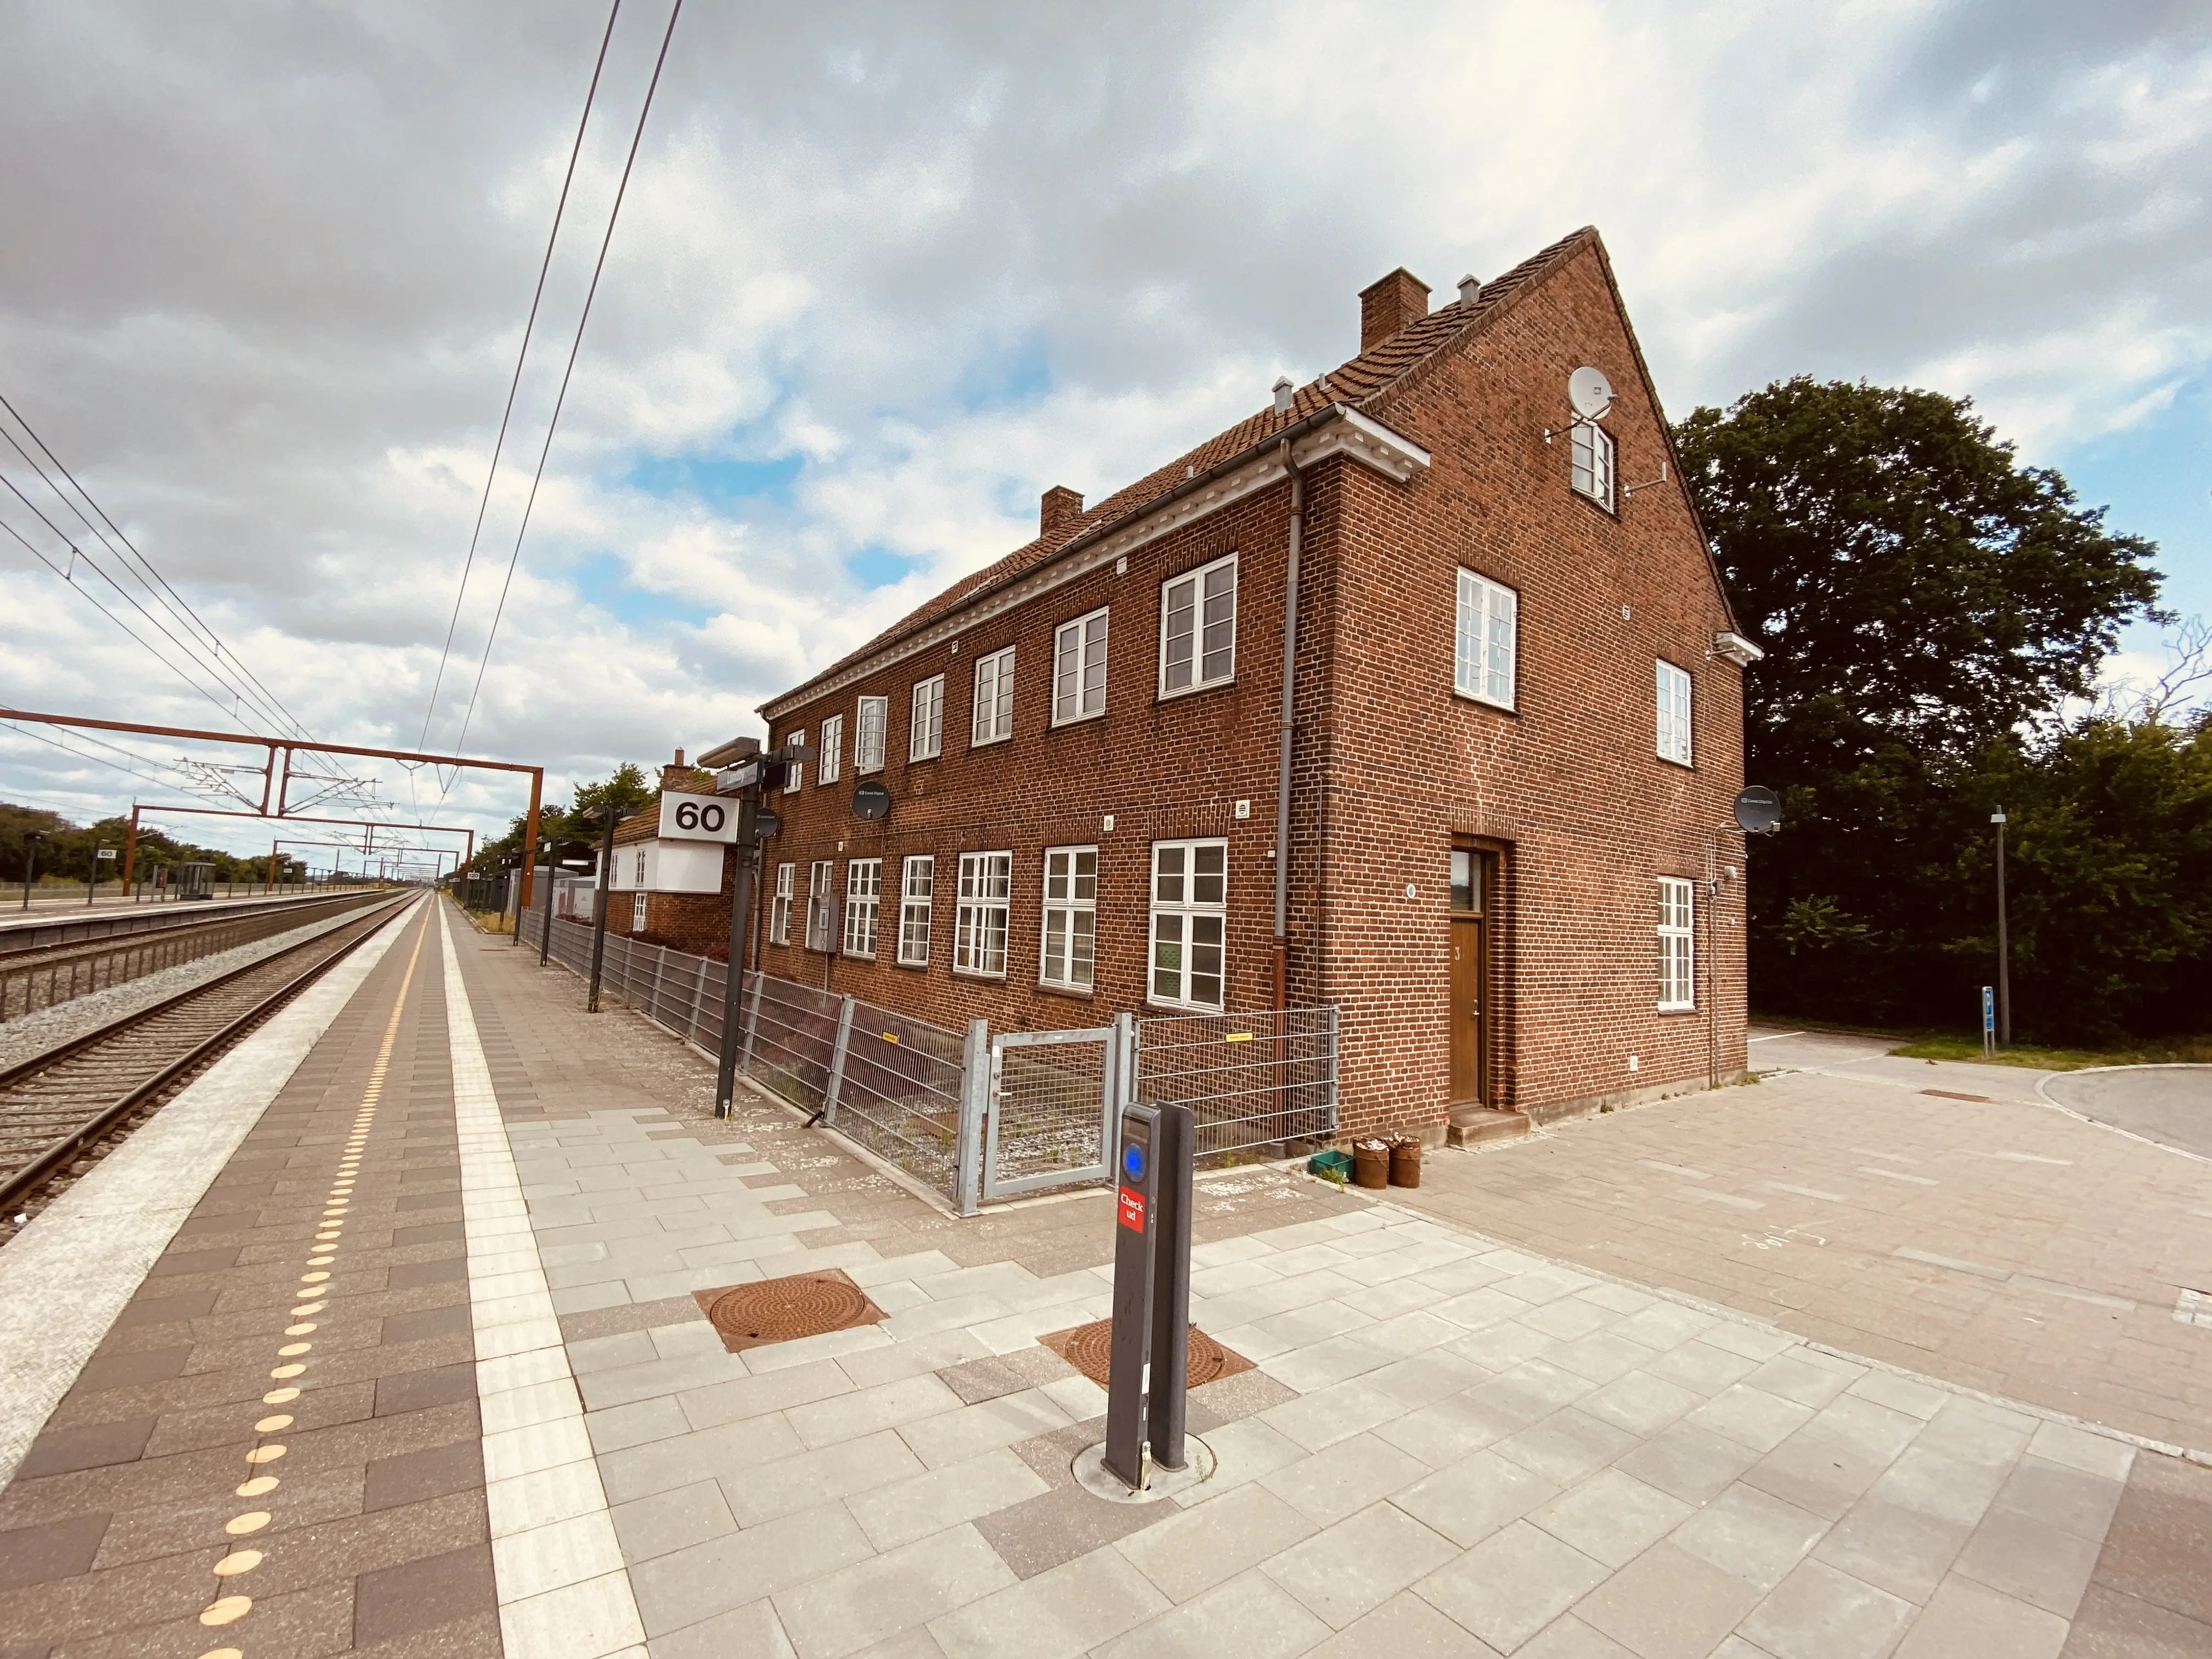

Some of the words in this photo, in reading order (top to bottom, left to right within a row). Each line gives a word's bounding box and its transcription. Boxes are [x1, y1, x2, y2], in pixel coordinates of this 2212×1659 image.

[676, 802, 725, 832] 60
[1121, 1193, 1143, 1212] Check
[1126, 1210, 1136, 1221] ud
